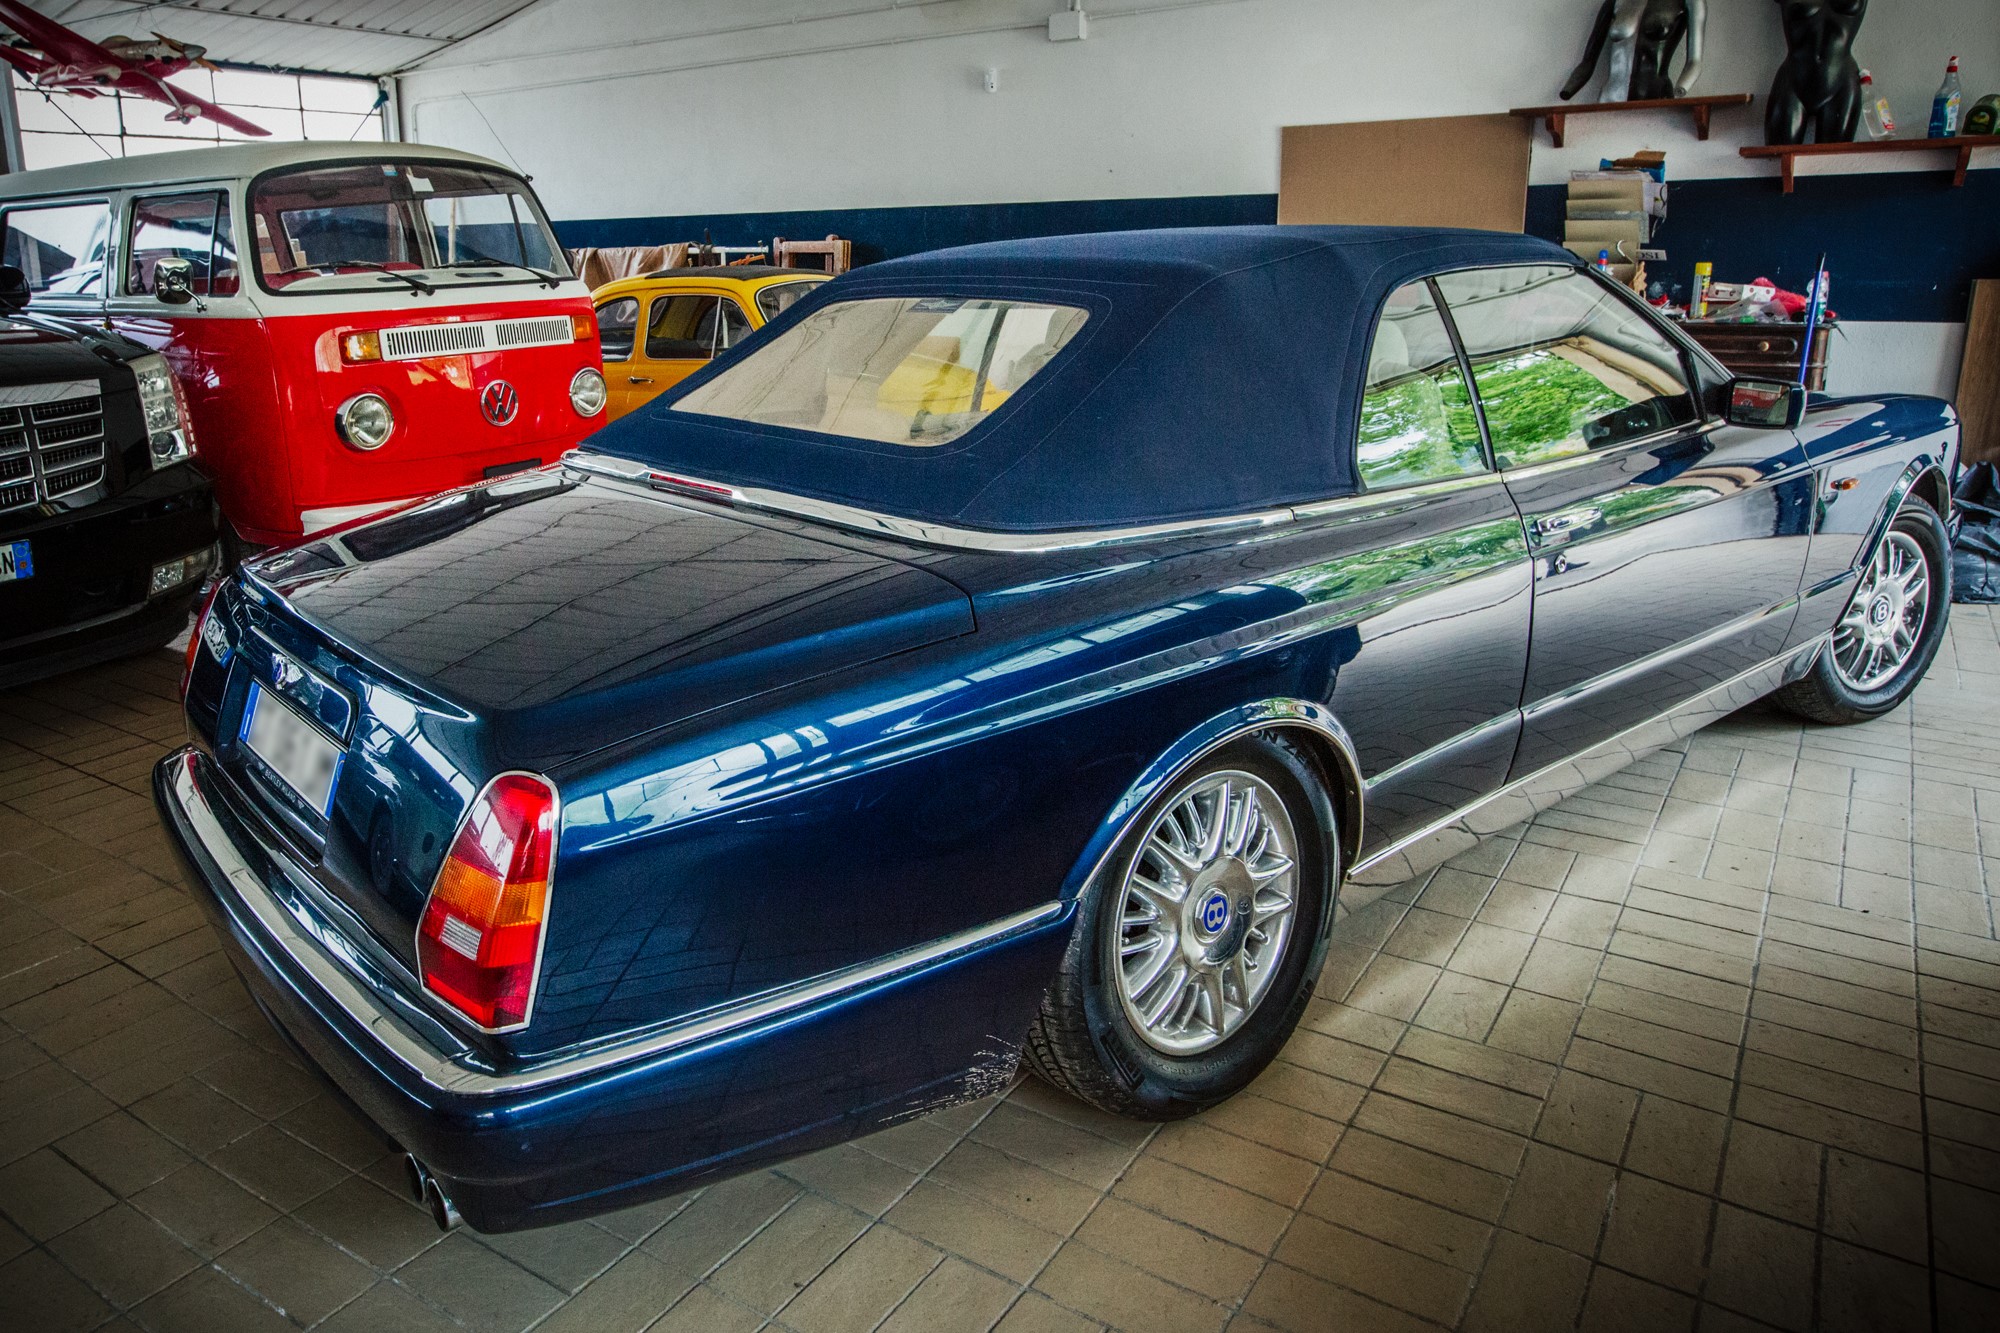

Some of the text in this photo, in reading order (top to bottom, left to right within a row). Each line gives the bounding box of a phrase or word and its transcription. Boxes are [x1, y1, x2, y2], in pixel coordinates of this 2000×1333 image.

[482, 380, 517, 425] VW
[0, 551, 15, 574] N
[264, 769, 297, 803] BENTLEY MILANO
[1207, 899, 1225, 929] B
